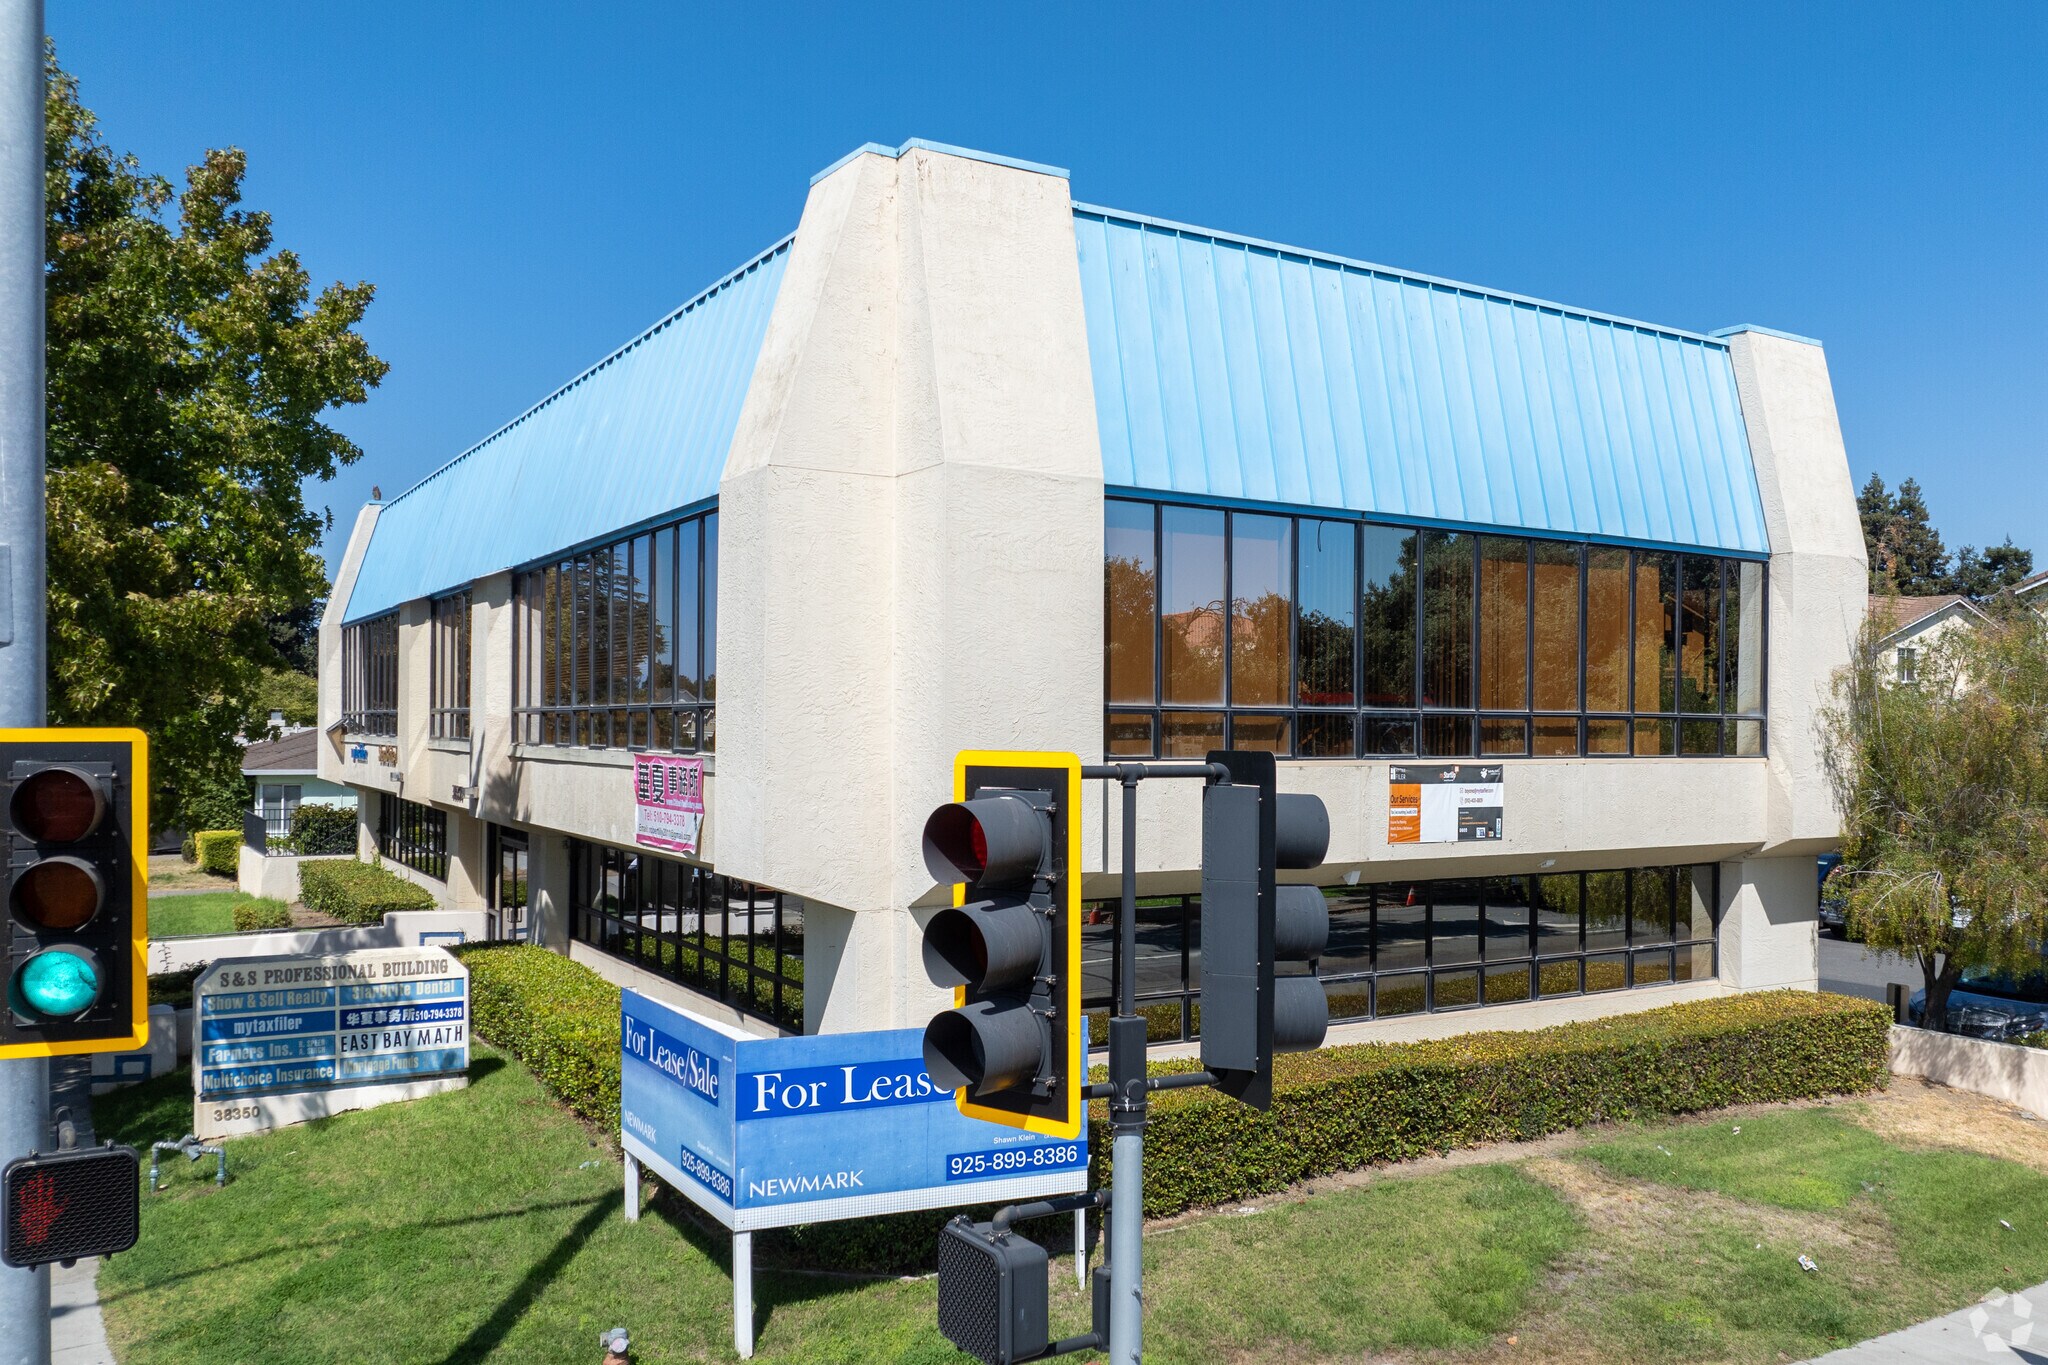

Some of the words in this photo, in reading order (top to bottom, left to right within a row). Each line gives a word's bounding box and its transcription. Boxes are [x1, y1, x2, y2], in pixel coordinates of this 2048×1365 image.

[1390, 794, 1399, 804] Our
[1400, 794, 1418, 804] Services
[654, 811, 686, 828] 510-794-3378
[264, 964, 377, 985] PROFESSIONAL
[382, 959, 448, 978] BUILDING
[416, 980, 454, 995] Dental
[207, 997, 243, 1012] Show
[248, 994, 256, 1008] &
[260, 990, 283, 1007] Sell
[287, 989, 328, 1005] Realty
[234, 1016, 302, 1036] mytaxfiler
[416, 1008, 462, 1021] 510-794-3378
[342, 1034, 378, 1052] EAST
[384, 1030, 411, 1048] BAY
[418, 1026, 462, 1046] MATH
[208, 1046, 264, 1062] Farmers
[270, 1044, 292, 1057] Ins.
[626, 1016, 646, 1056] For
[649, 1028, 718, 1099] Lease/Sale
[344, 1059, 390, 1074] Mortgage
[392, 1056, 418, 1070] Funds
[204, 1070, 272, 1090] Multichoice
[276, 1066, 334, 1082] Insurance
[752, 1073, 828, 1112] For
[214, 1106, 260, 1122] 38350
[624, 1109, 656, 1144] NEWMARK
[951, 1146, 1078, 1175] 925-899-8386
[682, 1150, 730, 1197] 925-899-8386
[749, 1170, 864, 1198] NEWMARK
